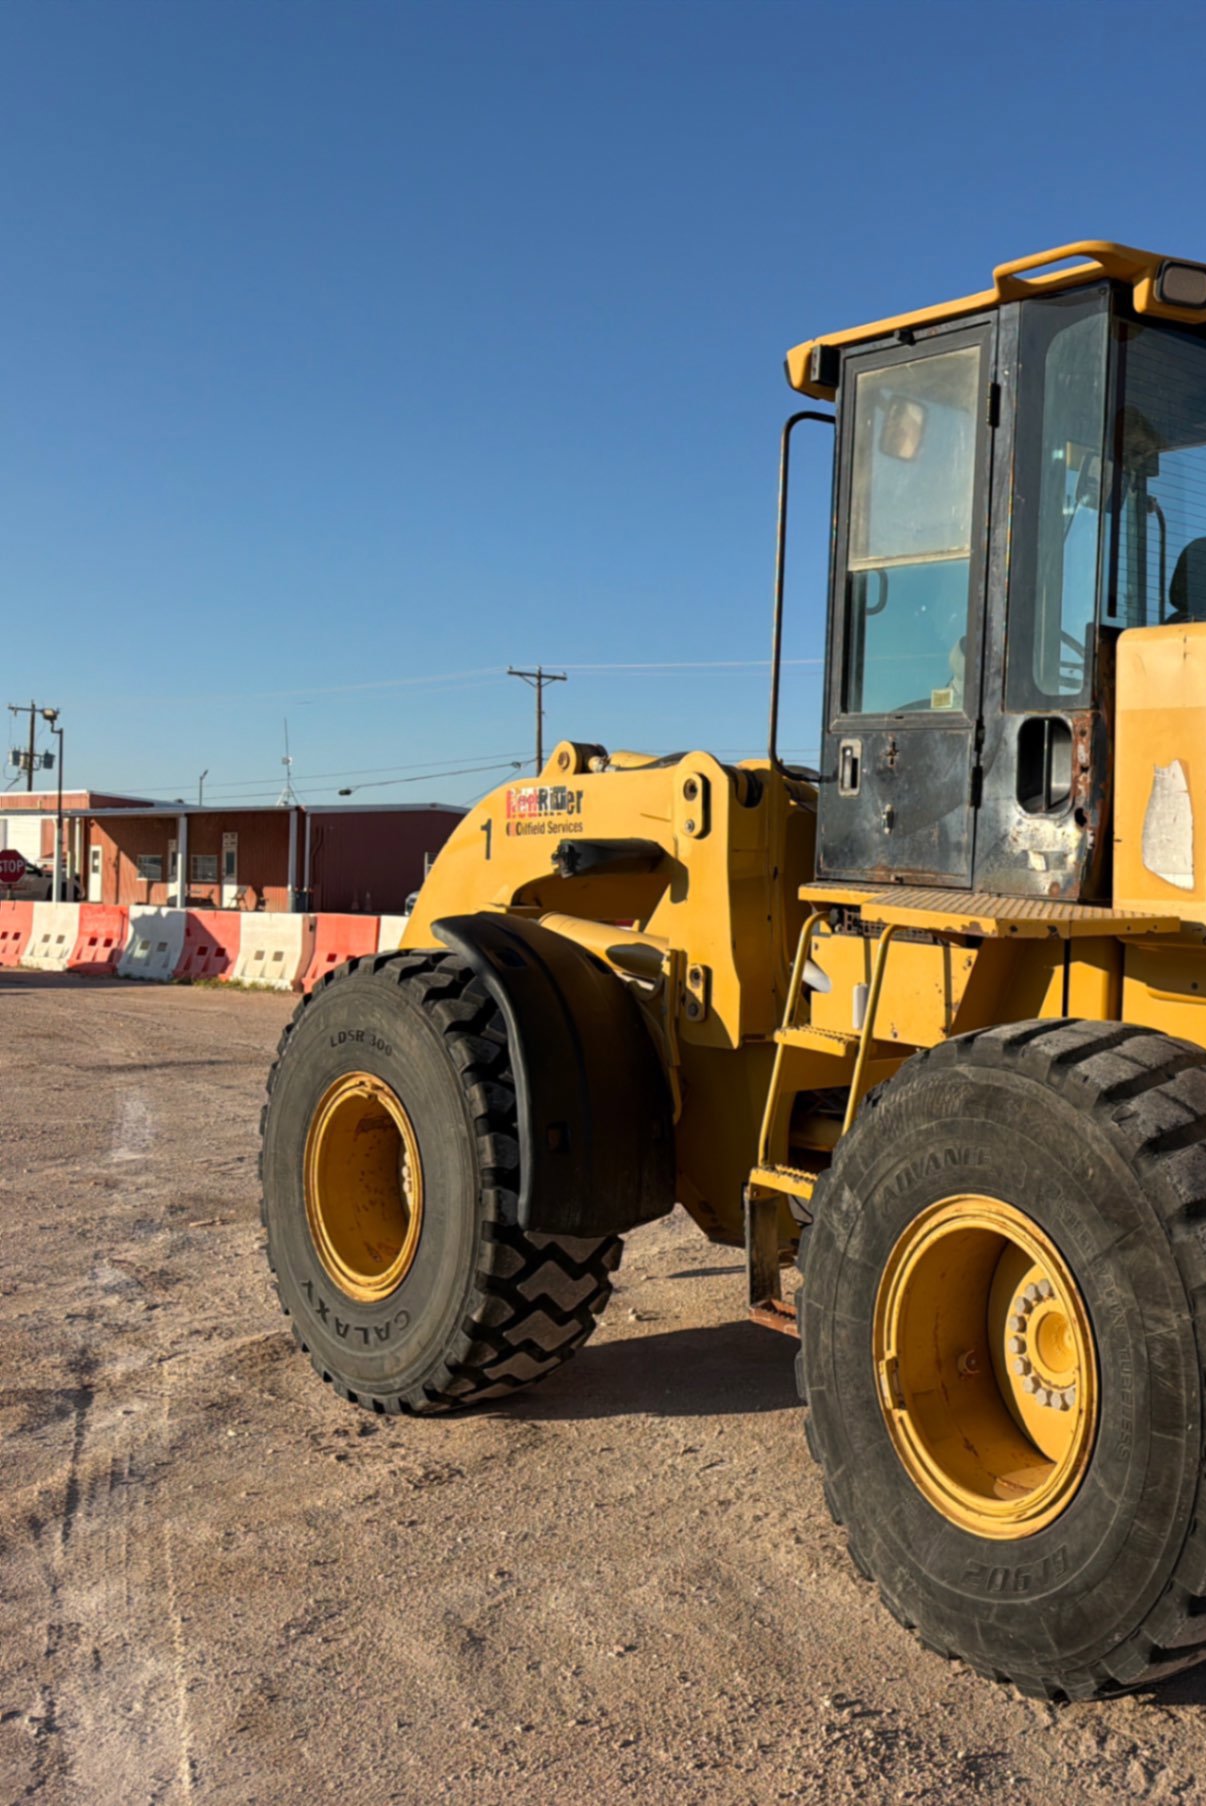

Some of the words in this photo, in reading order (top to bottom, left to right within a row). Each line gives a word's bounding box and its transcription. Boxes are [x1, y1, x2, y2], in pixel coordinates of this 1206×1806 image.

[480, 818, 492, 861] 1
[547, 820, 583, 834] Services
[329, 1029, 365, 1048] LDSR
[368, 1034, 393, 1057] 300
